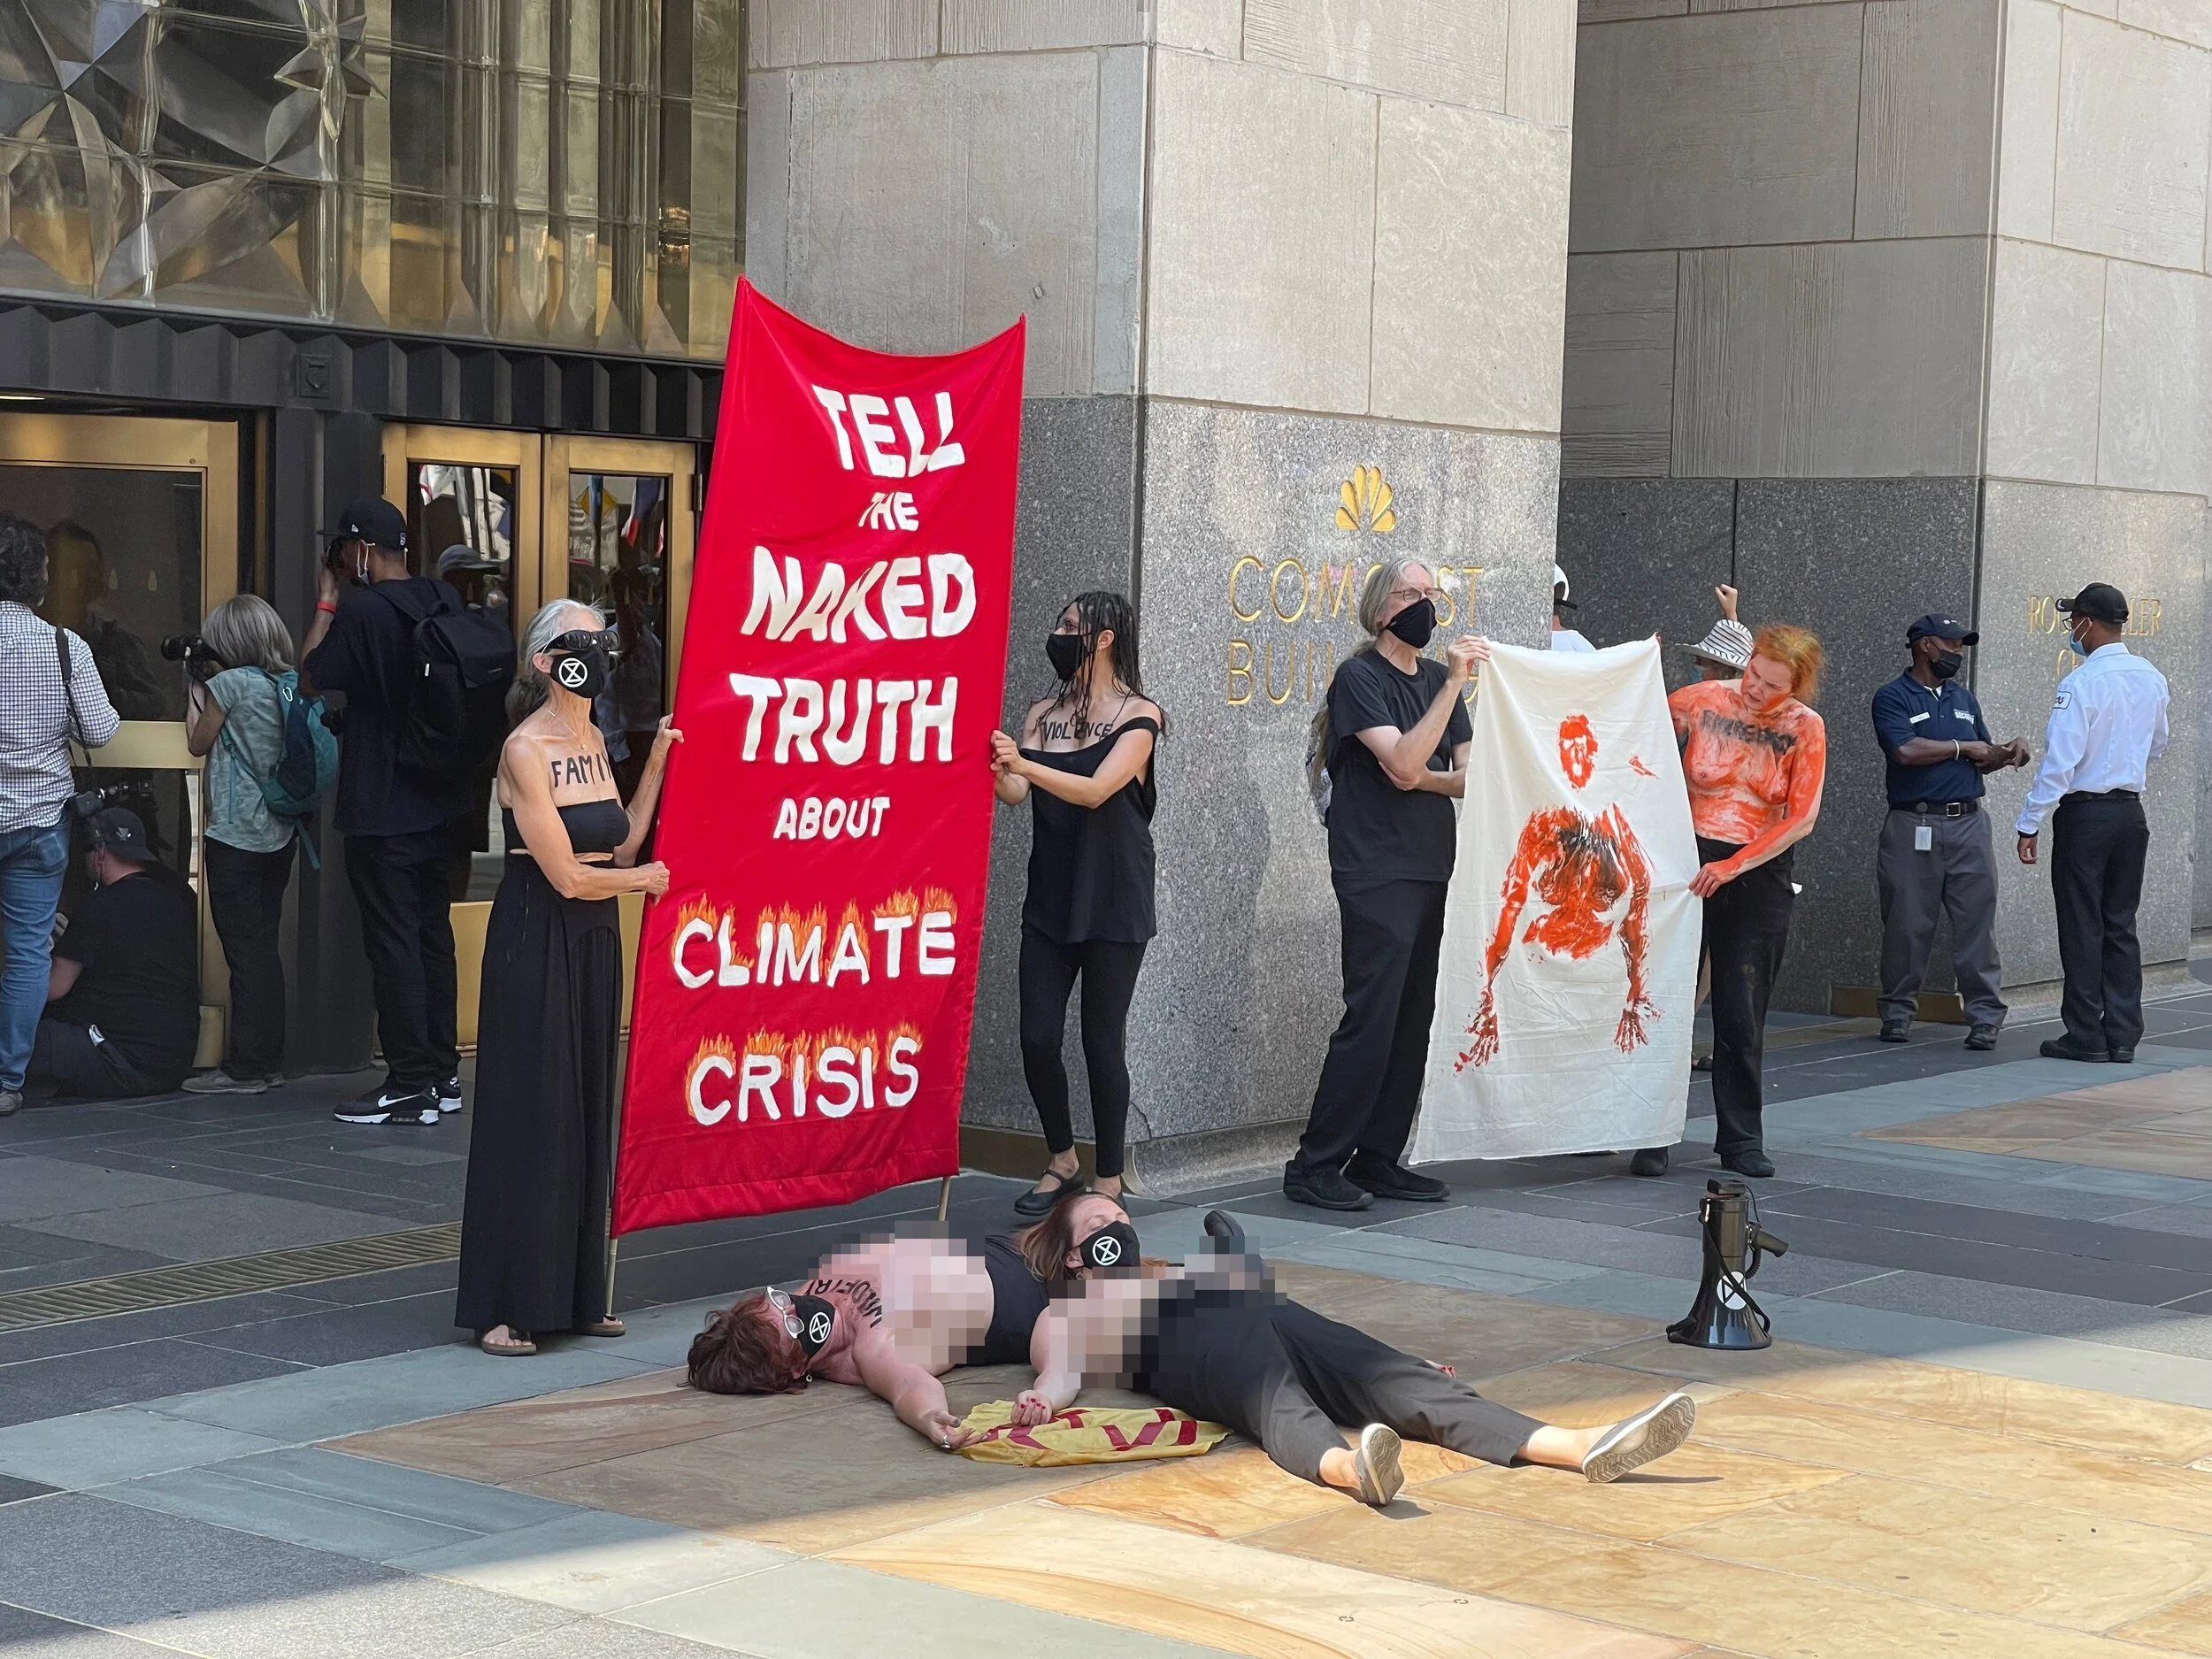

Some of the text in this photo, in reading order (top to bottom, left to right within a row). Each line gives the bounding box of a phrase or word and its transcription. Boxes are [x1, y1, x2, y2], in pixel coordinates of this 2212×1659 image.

[811, 383, 965, 478] TELL
[857, 491, 919, 532] THE
[741, 545, 977, 643] NAKED
[1227, 556, 1485, 627] COMST
[729, 672, 958, 765] TRUTH
[1044, 720, 1113, 742] VIOLENCE
[772, 796, 890, 840] ABOUT
[672, 910, 957, 989] CLIMATE
[688, 1034, 921, 1126] CRISIS
